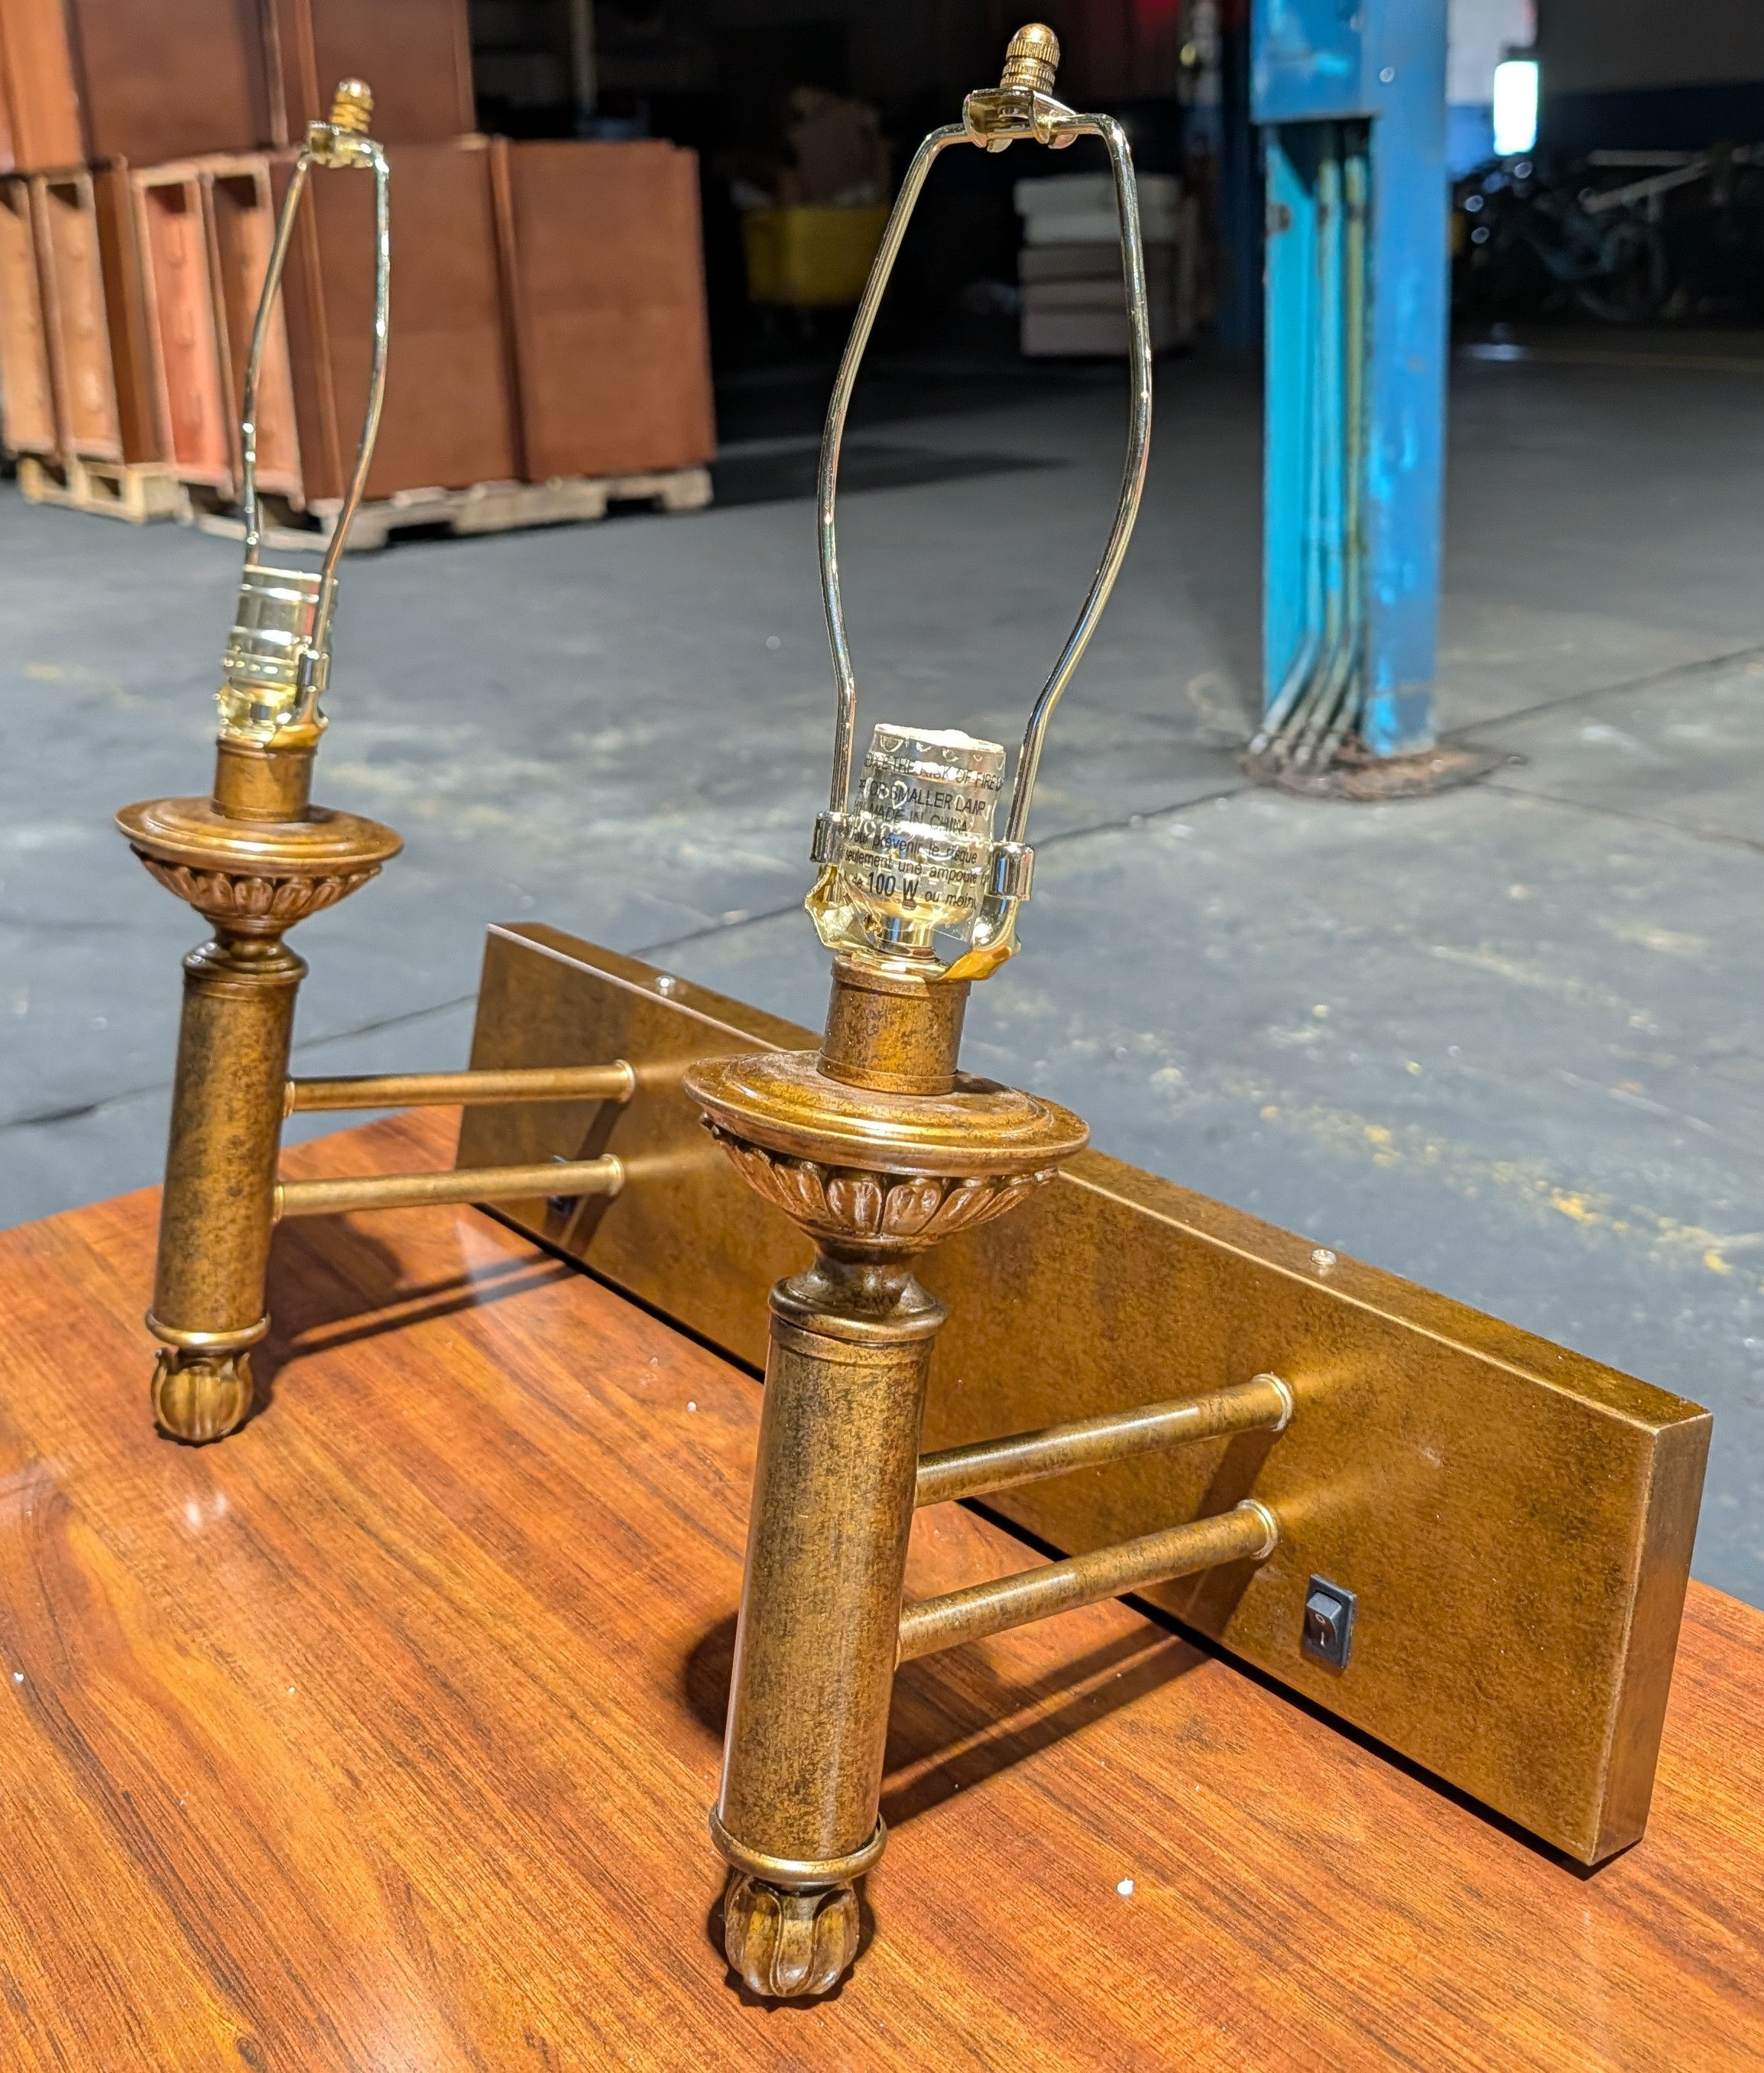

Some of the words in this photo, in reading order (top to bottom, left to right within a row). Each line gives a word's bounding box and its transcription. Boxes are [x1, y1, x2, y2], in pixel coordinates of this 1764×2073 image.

[892, 755, 916, 775] THE
[955, 767, 973, 784] OF
[869, 803, 904, 824] MADE
[909, 809, 925, 824] IN
[930, 814, 967, 835] CHINA
[929, 841, 940, 856] le
[845, 848, 893, 869] seulement
[897, 861, 923, 876] une
[929, 866, 978, 885] ampoule
[868, 871, 897, 897] 100
[903, 878, 919, 902] W
[925, 891, 941, 903] ou
